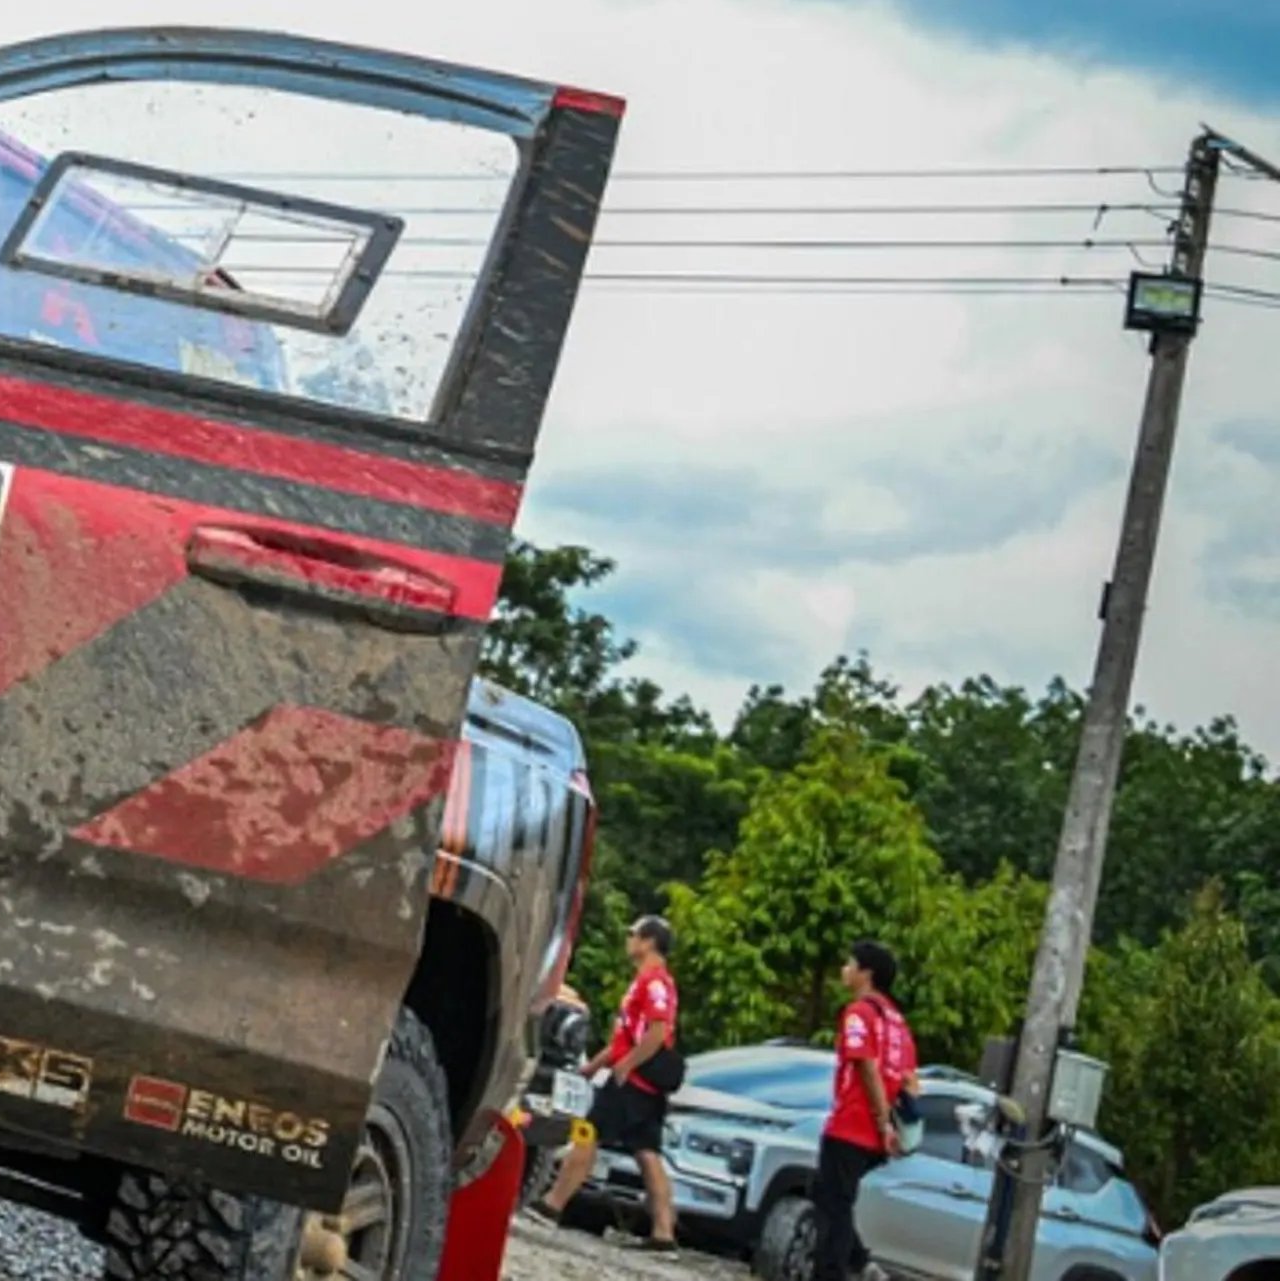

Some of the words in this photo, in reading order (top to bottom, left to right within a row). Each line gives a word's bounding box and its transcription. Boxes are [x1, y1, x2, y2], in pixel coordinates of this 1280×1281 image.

[181, 1118, 276, 1158] MOTOR
[281, 1144, 323, 1170] OIL
[185, 1088, 331, 1149] ENEOS
